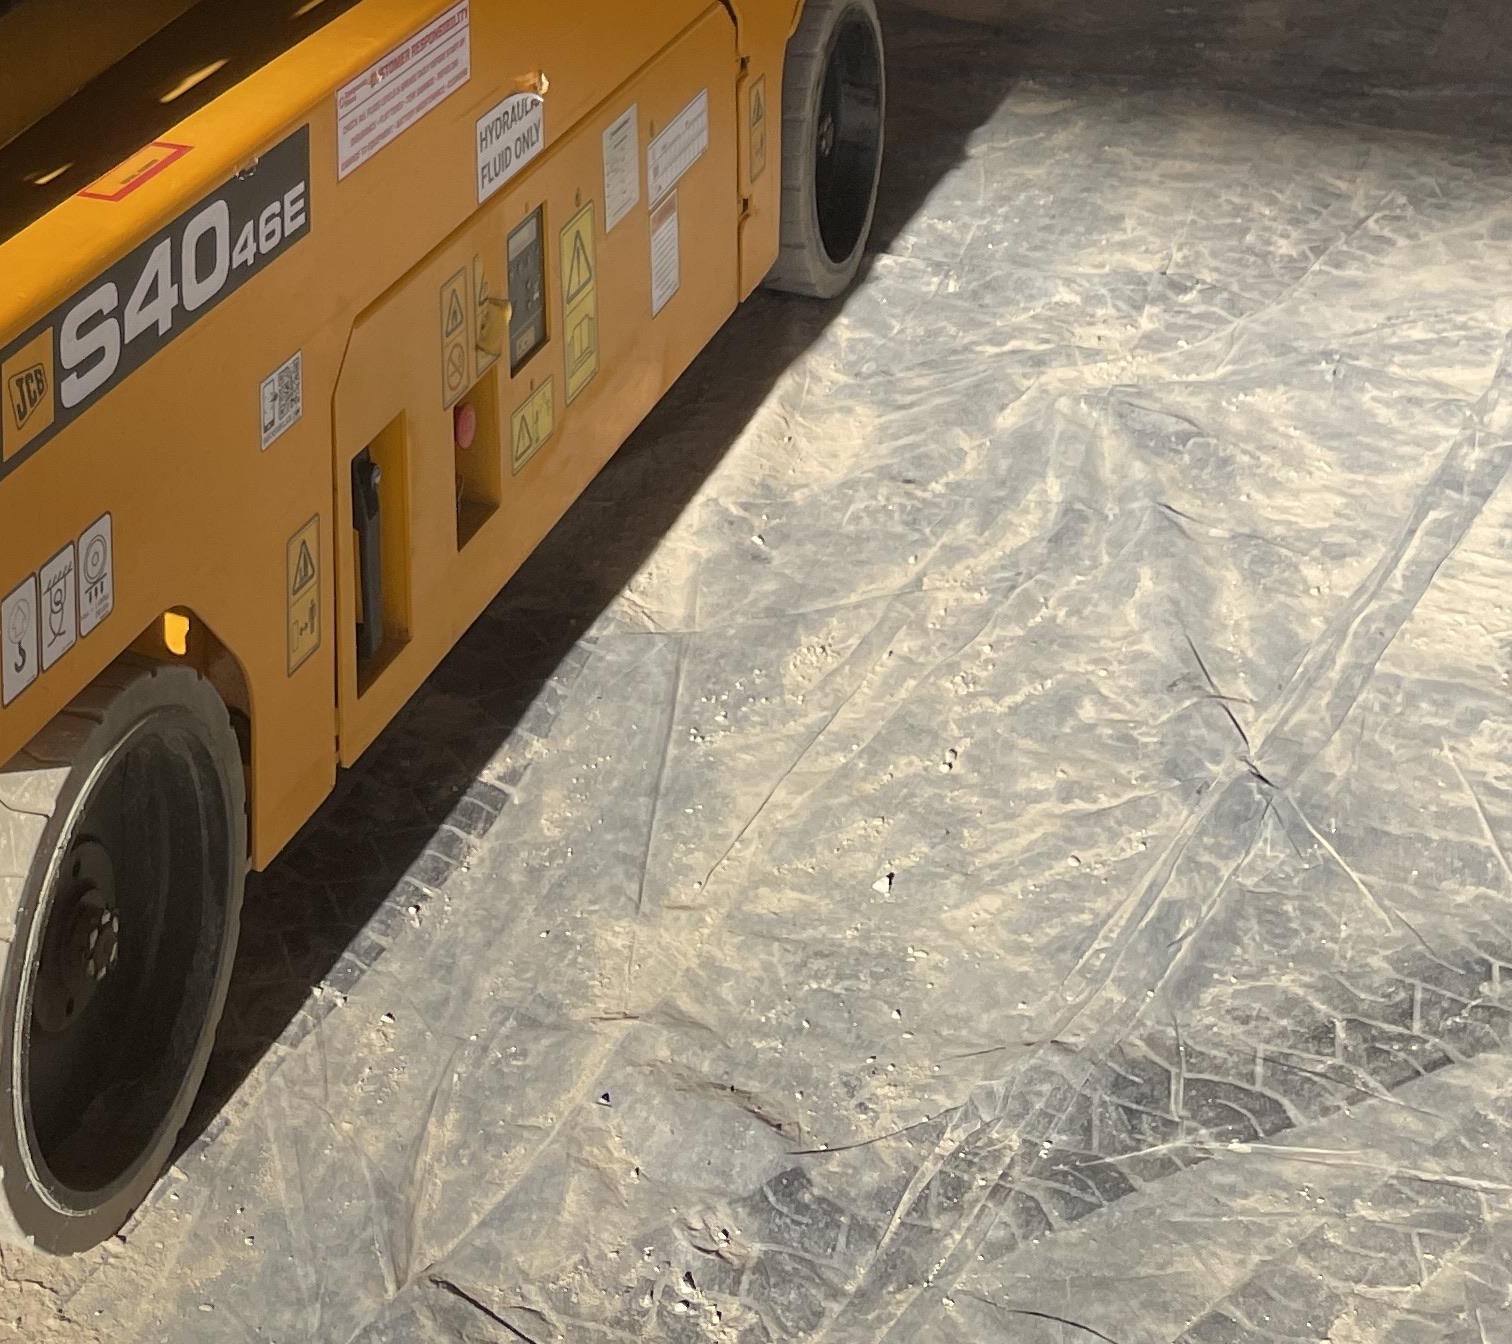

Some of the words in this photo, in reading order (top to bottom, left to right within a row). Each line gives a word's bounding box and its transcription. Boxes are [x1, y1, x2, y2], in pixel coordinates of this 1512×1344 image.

[481, 146, 512, 190] FLUID
[514, 119, 541, 160] ONLY
[15, 368, 45, 421] JCB
